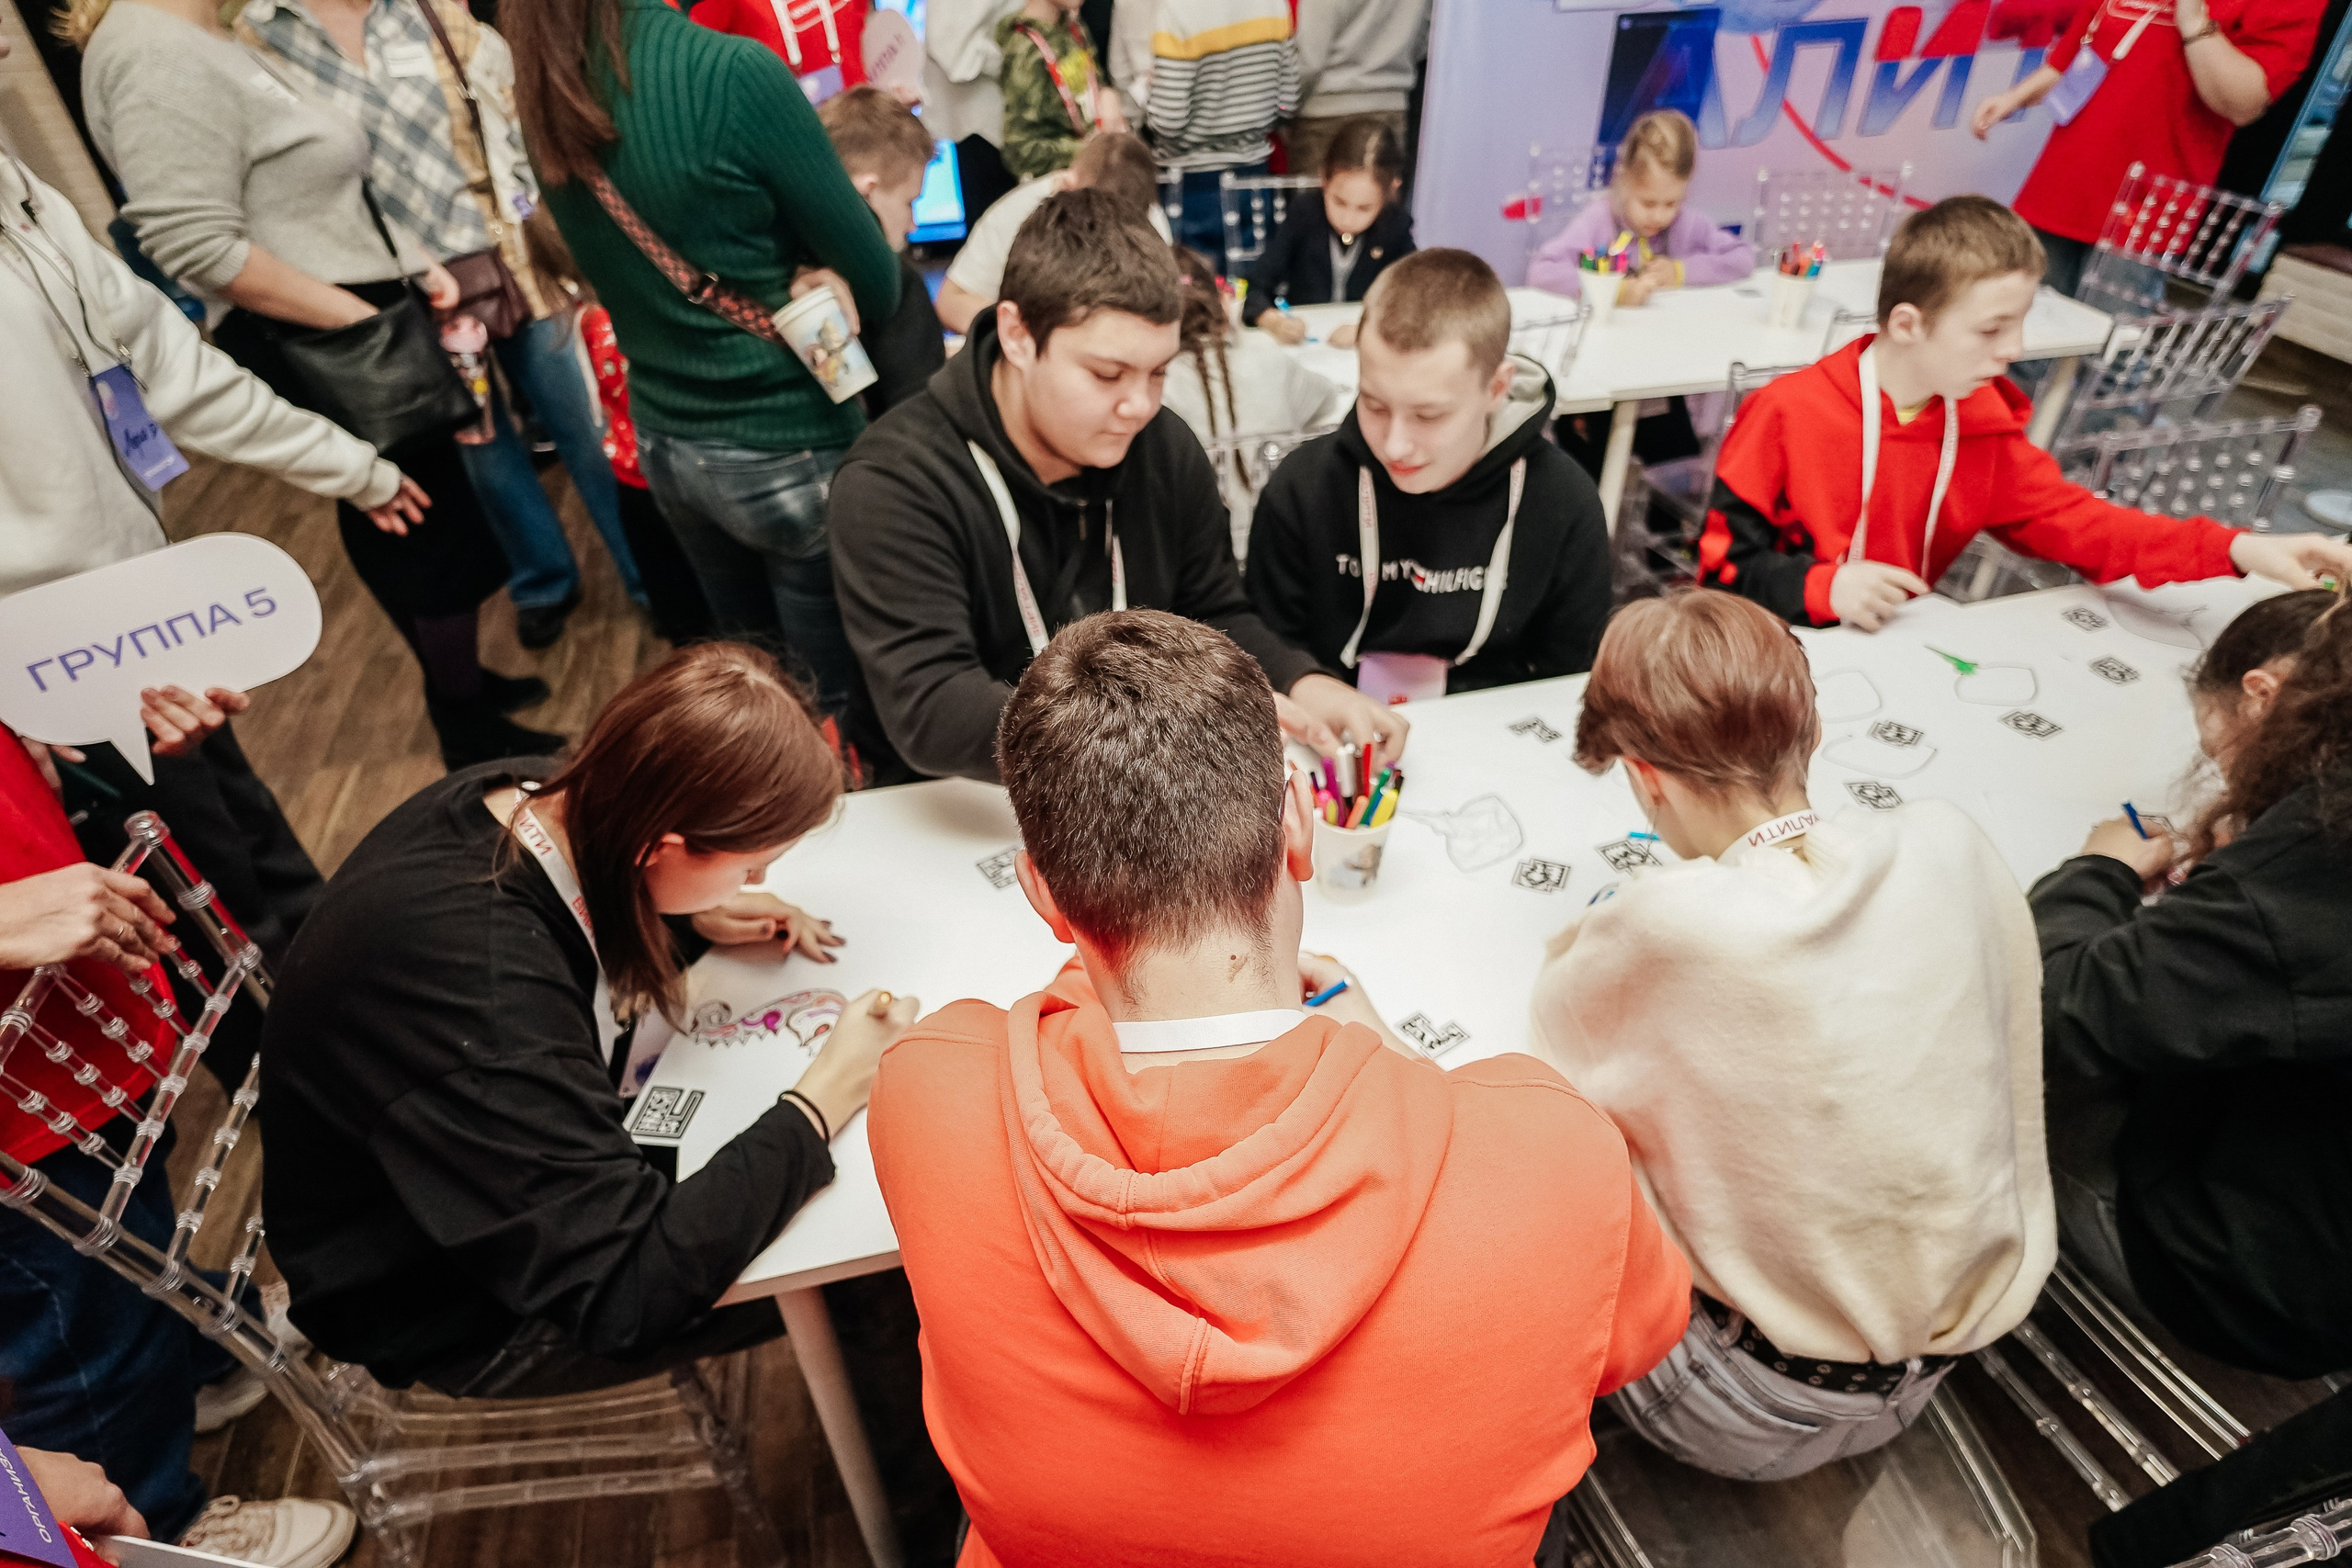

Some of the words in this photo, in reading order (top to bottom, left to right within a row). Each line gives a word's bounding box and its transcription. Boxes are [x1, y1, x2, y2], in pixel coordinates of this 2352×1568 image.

[1336, 553, 1415, 581] TOMY
[26, 603, 243, 693] ГРУППА
[243, 586, 277, 619] 5
[516, 812, 553, 856] ИТИ
[0, 1447, 52, 1544] ОРГАНИЗ
